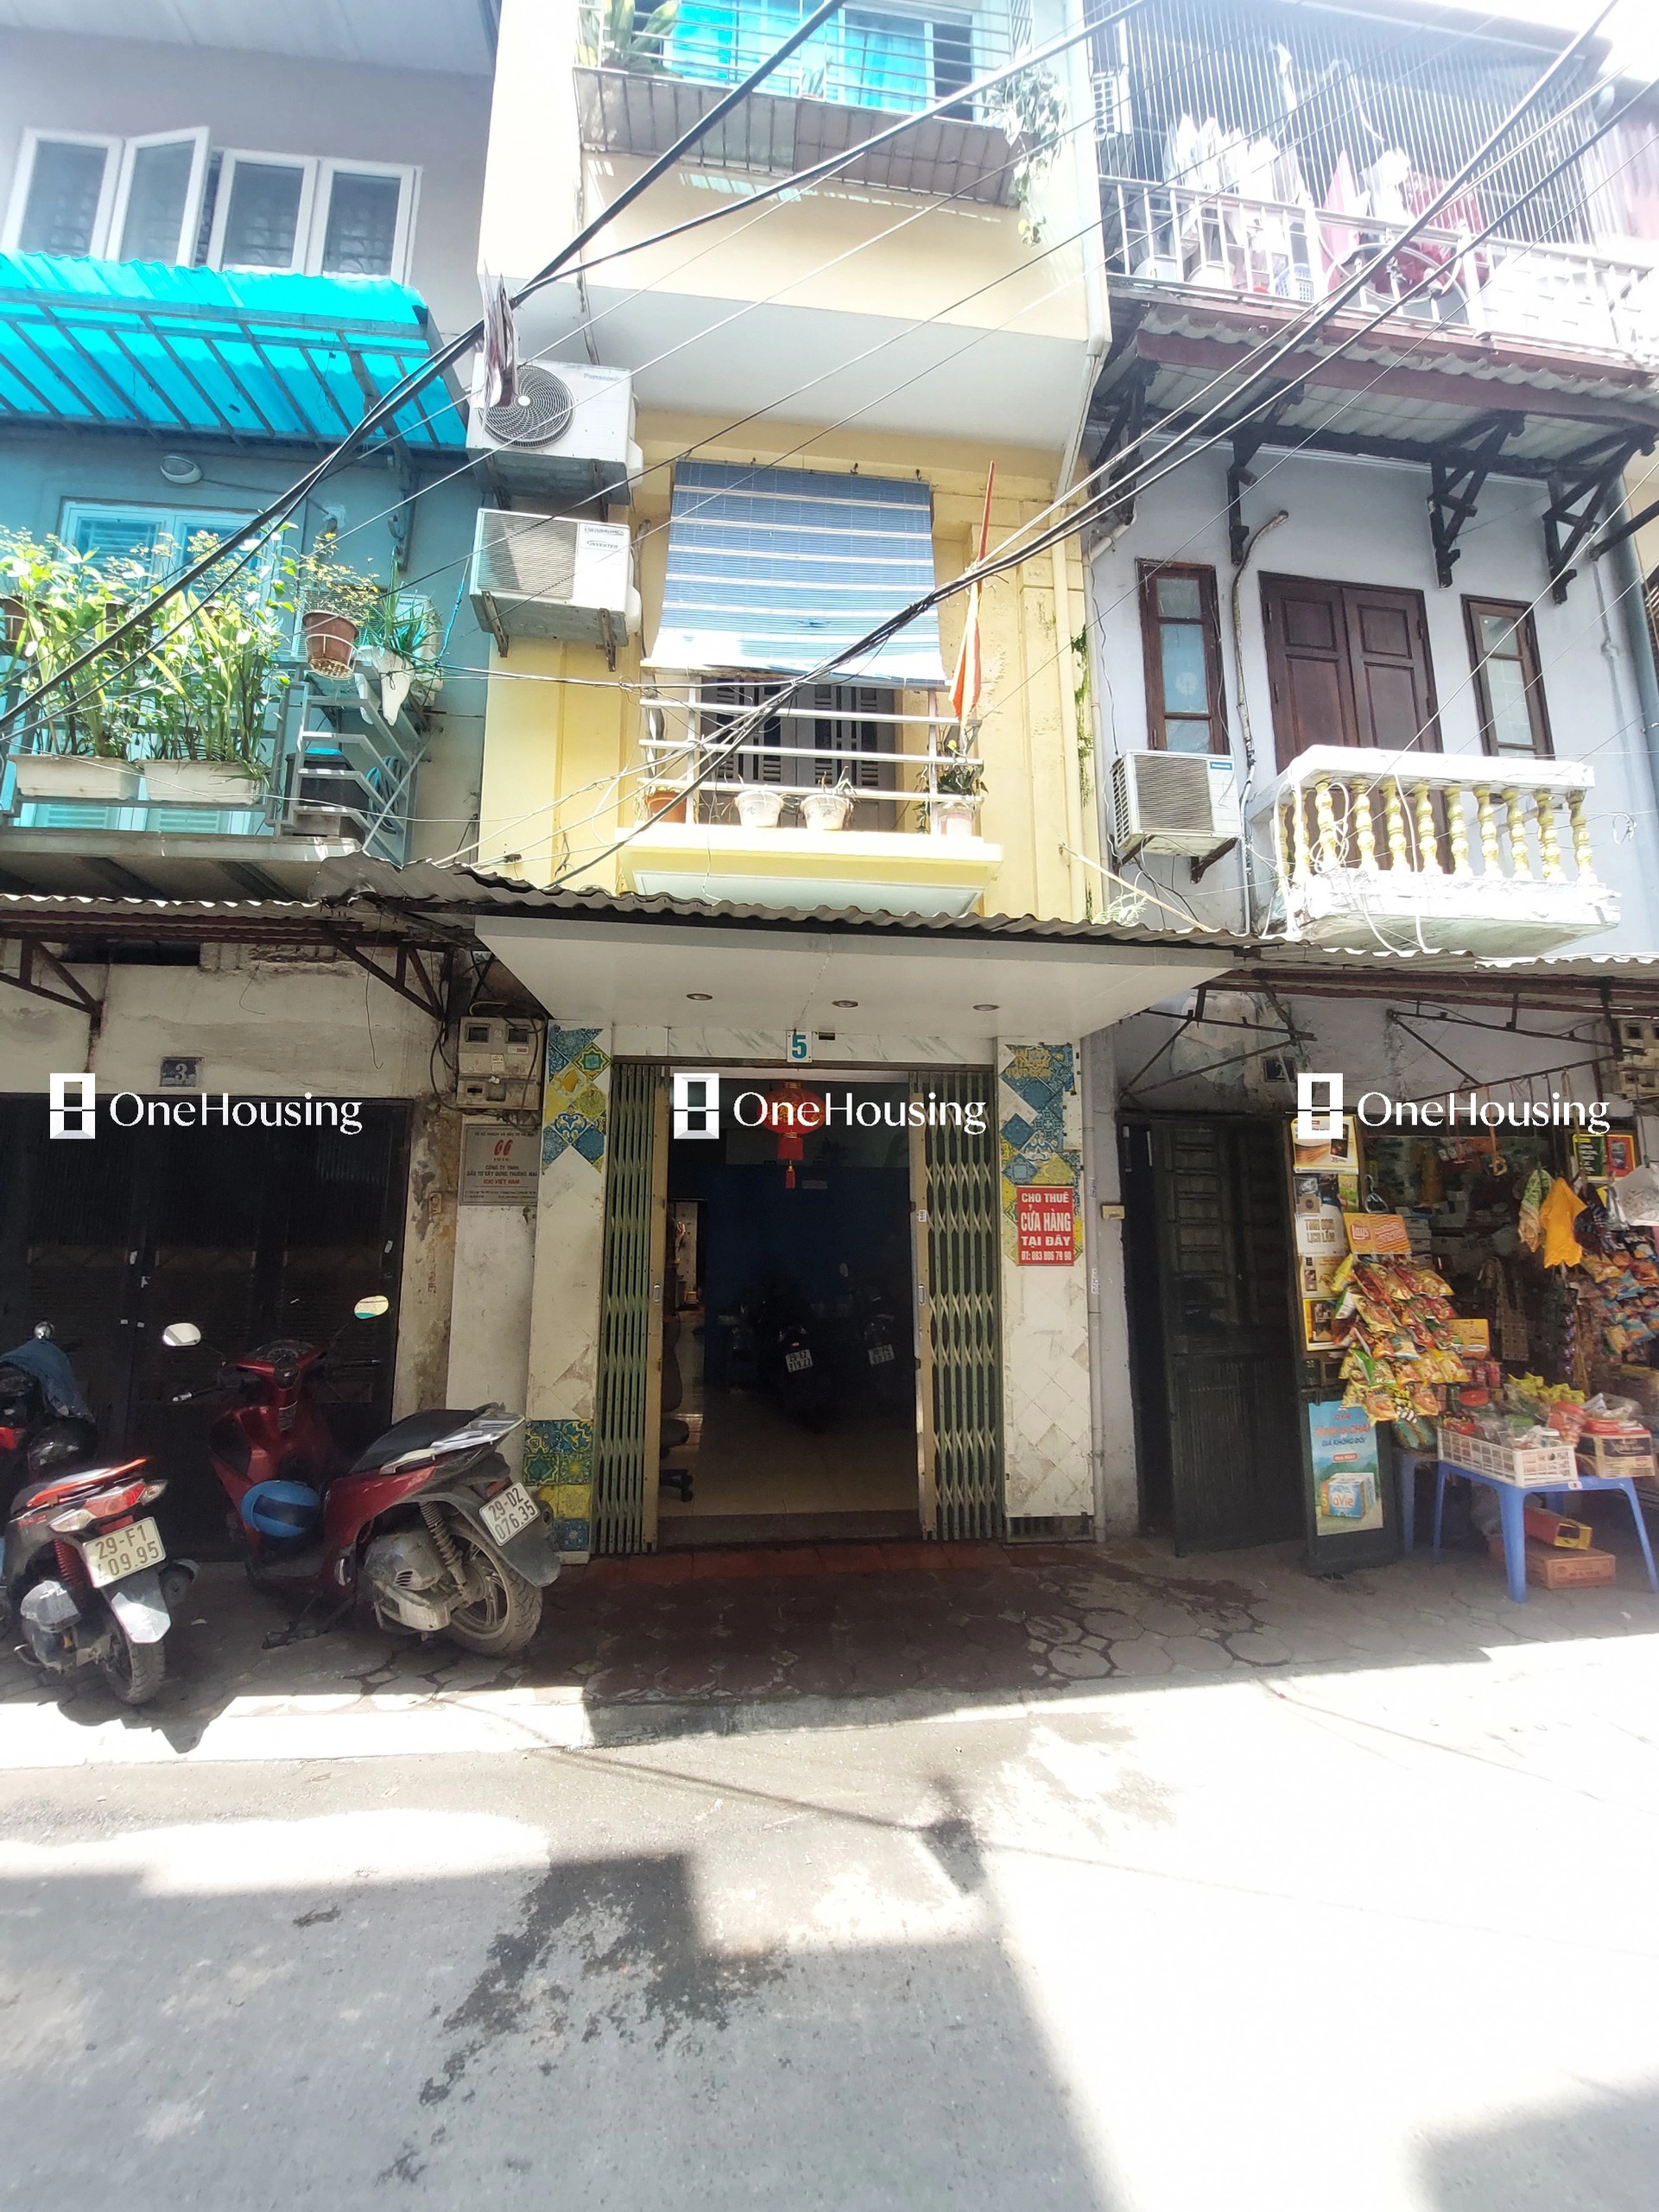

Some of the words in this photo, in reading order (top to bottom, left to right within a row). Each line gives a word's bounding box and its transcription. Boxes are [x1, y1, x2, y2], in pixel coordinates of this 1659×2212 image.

[792, 1034, 807, 1059] 5
[175, 1063, 187, 1081] 3
[1021, 1193, 1042, 1203] CHO
[1043, 1191, 1070, 1203] THUÊ
[1021, 1203, 1042, 1232] CỬA
[1042, 1208, 1071, 1232] HÀNG
[1021, 1236, 1042, 1248] TẠI
[1045, 1234, 1071, 1246] ĐÂY
[488, 1487, 523, 1521] 29-D2
[494, 1499, 535, 1540] 076.35
[95, 1524, 146, 1560] 29-F1
